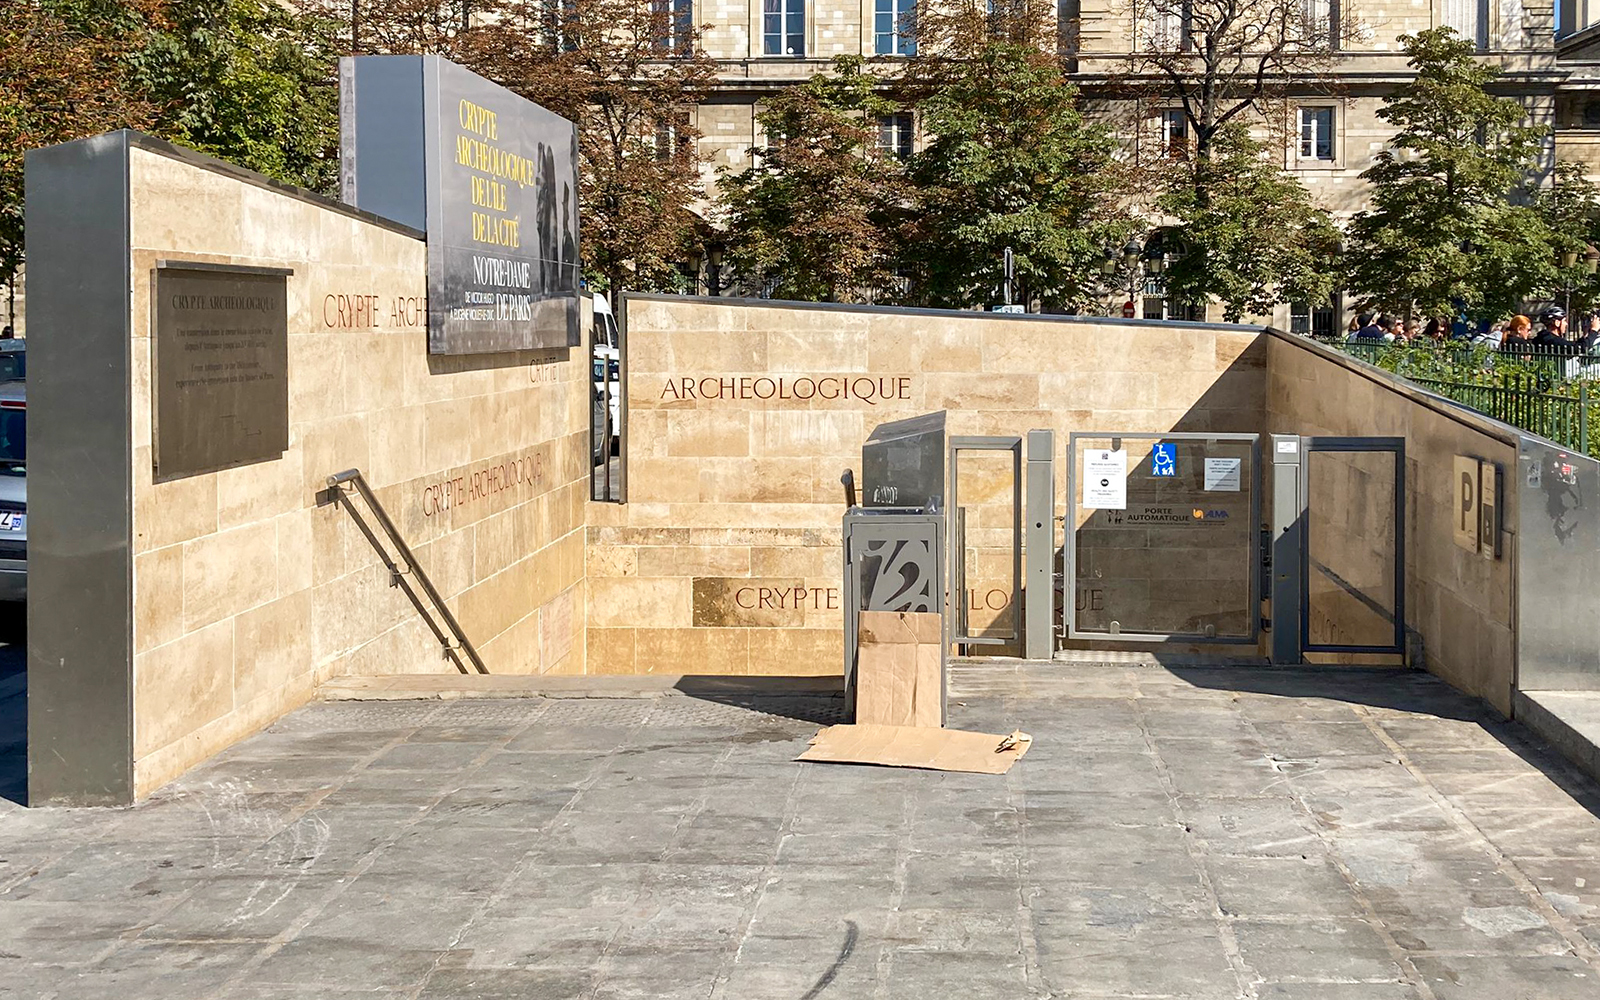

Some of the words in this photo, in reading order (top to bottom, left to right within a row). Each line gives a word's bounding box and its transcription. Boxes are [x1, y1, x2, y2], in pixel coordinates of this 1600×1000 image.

[459, 99, 498, 140] CRYPTE
[455, 134, 534, 189] ARCHÉOLOGIQUE
[472, 175, 486, 206] DE
[472, 212, 486, 242] DE
[487, 215, 500, 244] LA
[499, 215, 519, 248] CITÉ
[473, 256, 530, 288] NOTRE-DAME
[172, 294, 206, 310] CRYPTE
[323, 294, 379, 328] CRYPTE
[496, 293, 508, 321] DE
[509, 294, 532, 321] PARIS
[529, 357, 558, 383] CRYPTE
[660, 377, 911, 405] ARCHEOLOGIQUE
[422, 477, 464, 517] CRYPTE
[467, 452, 543, 503] ARCHEOLOGIQUE
[1127, 514, 1191, 522] AUTOMATIQUE
[735, 587, 839, 610] CRYPTE
